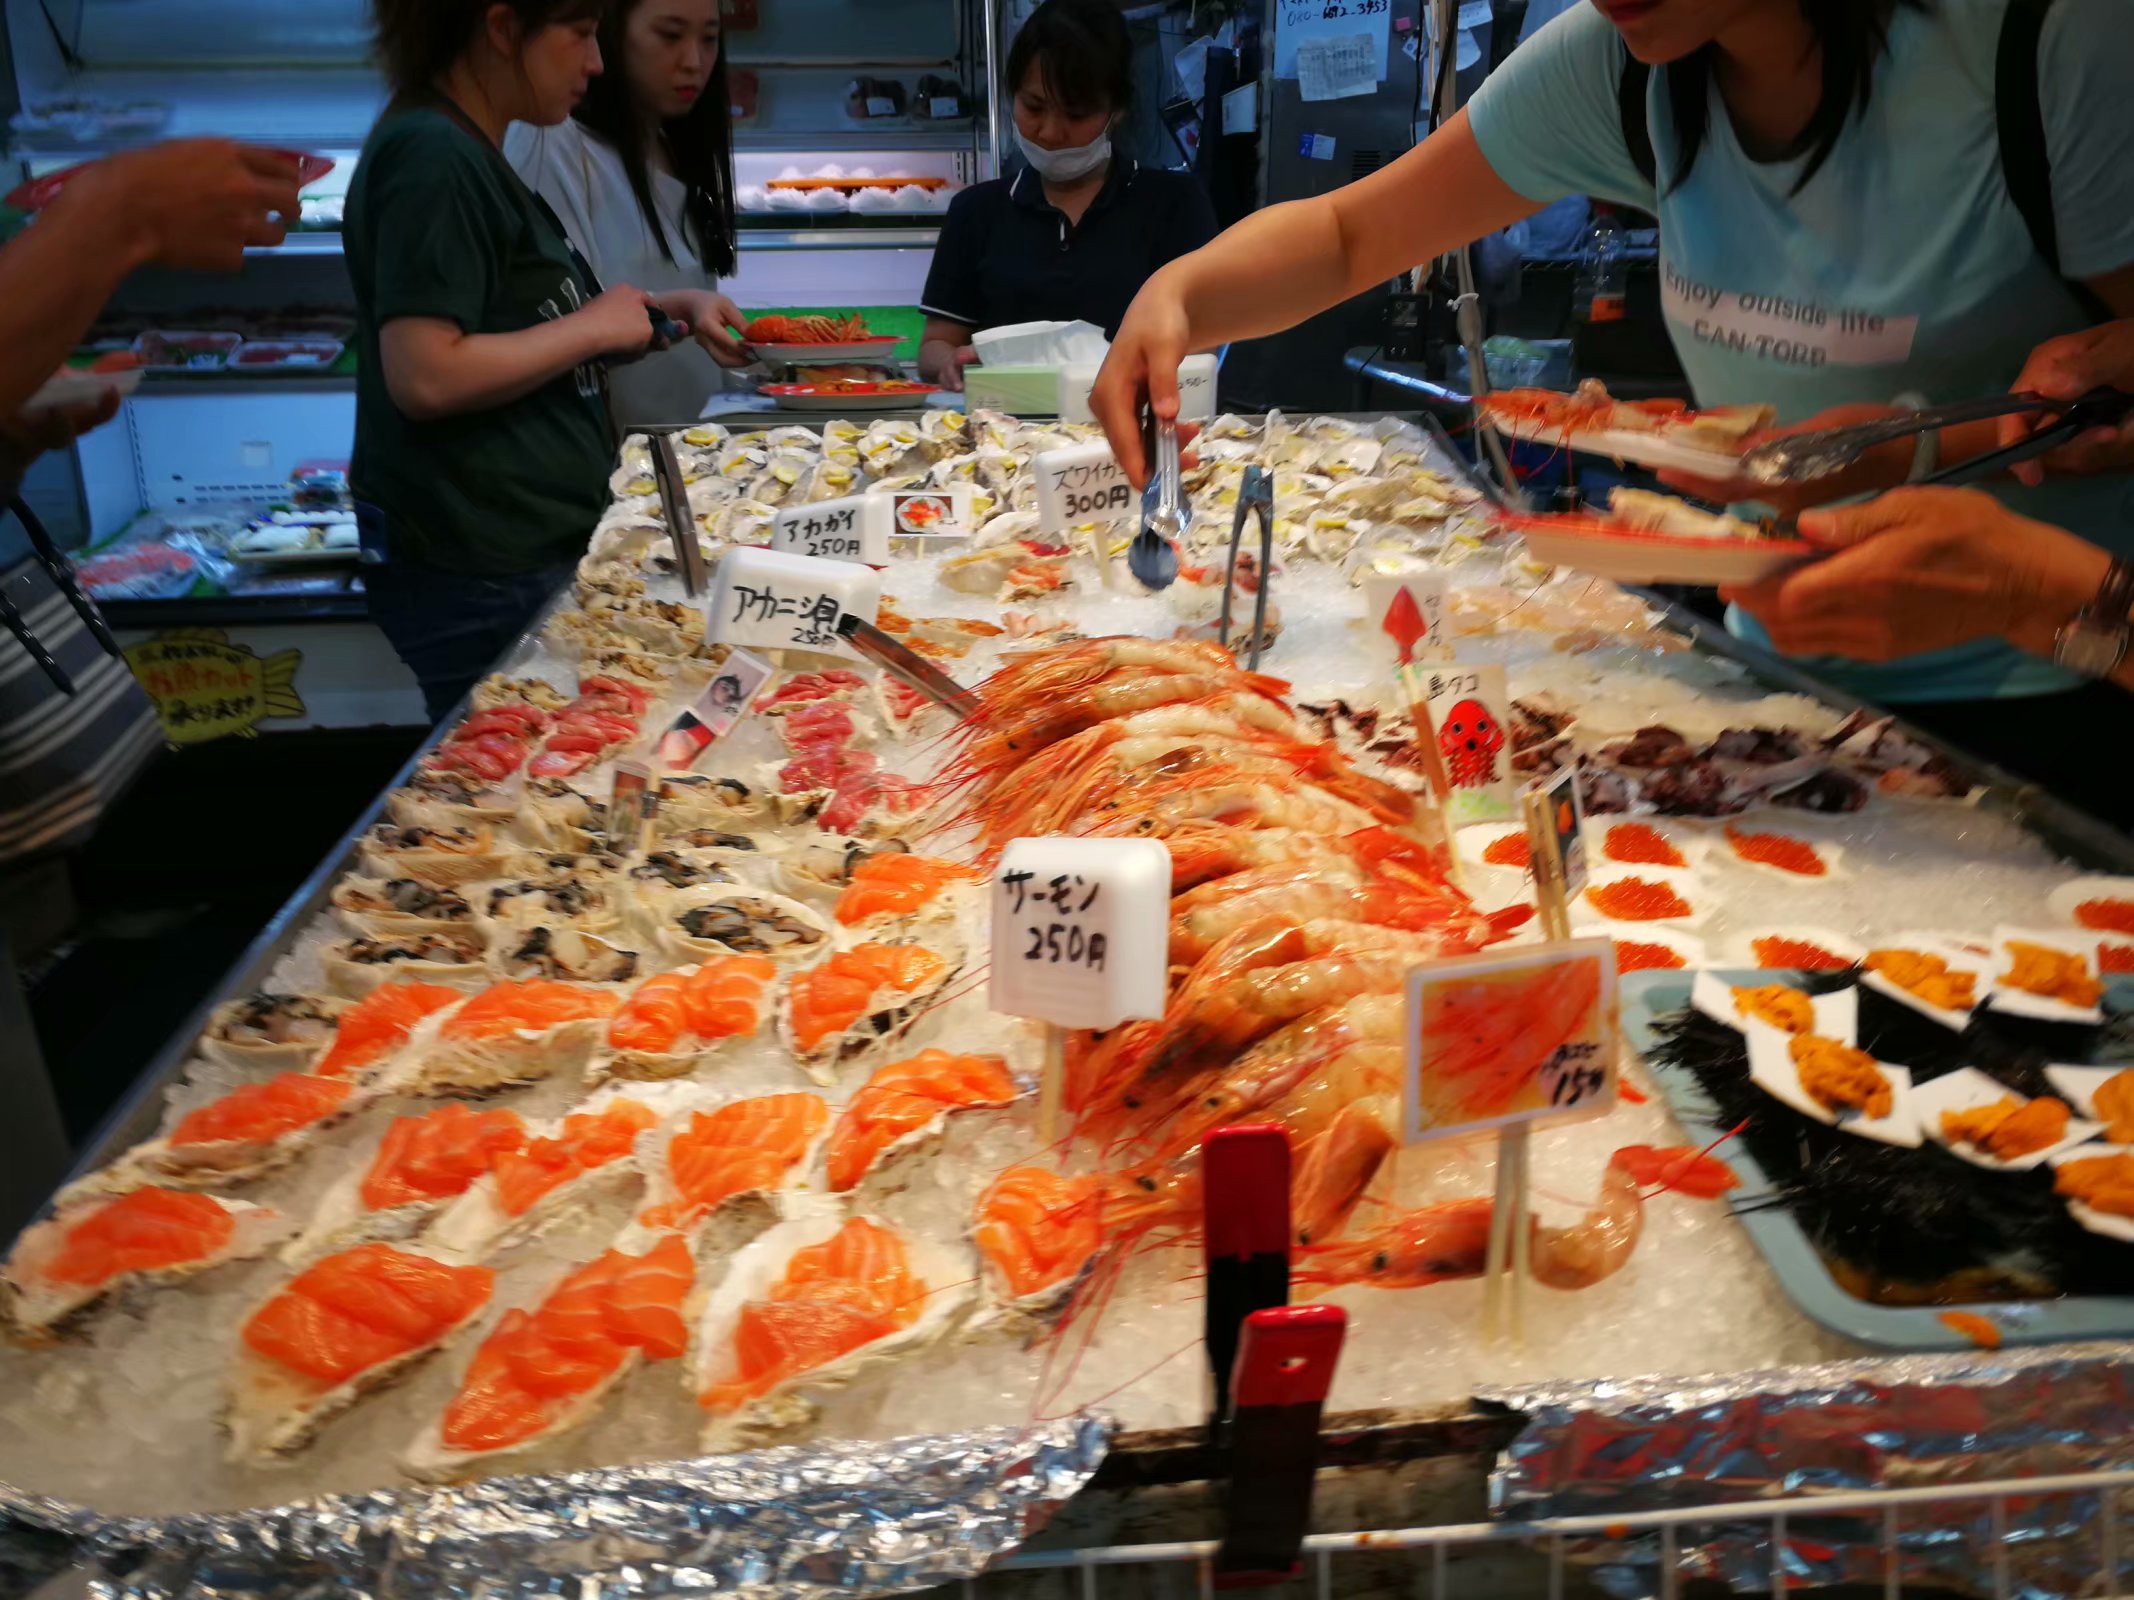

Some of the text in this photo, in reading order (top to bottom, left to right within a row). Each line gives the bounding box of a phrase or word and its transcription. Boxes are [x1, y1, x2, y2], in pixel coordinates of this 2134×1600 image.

[1665, 263, 1886, 334] Enjoy outside life
[1051, 460, 1126, 491] ズワイガ
[1064, 484, 1130, 518] 300円
[783, 509, 856, 542] アカガイ
[805, 538, 861, 556] 250円
[1001, 868, 1100, 915] サーモン
[1024, 924, 1107, 973] 250円
